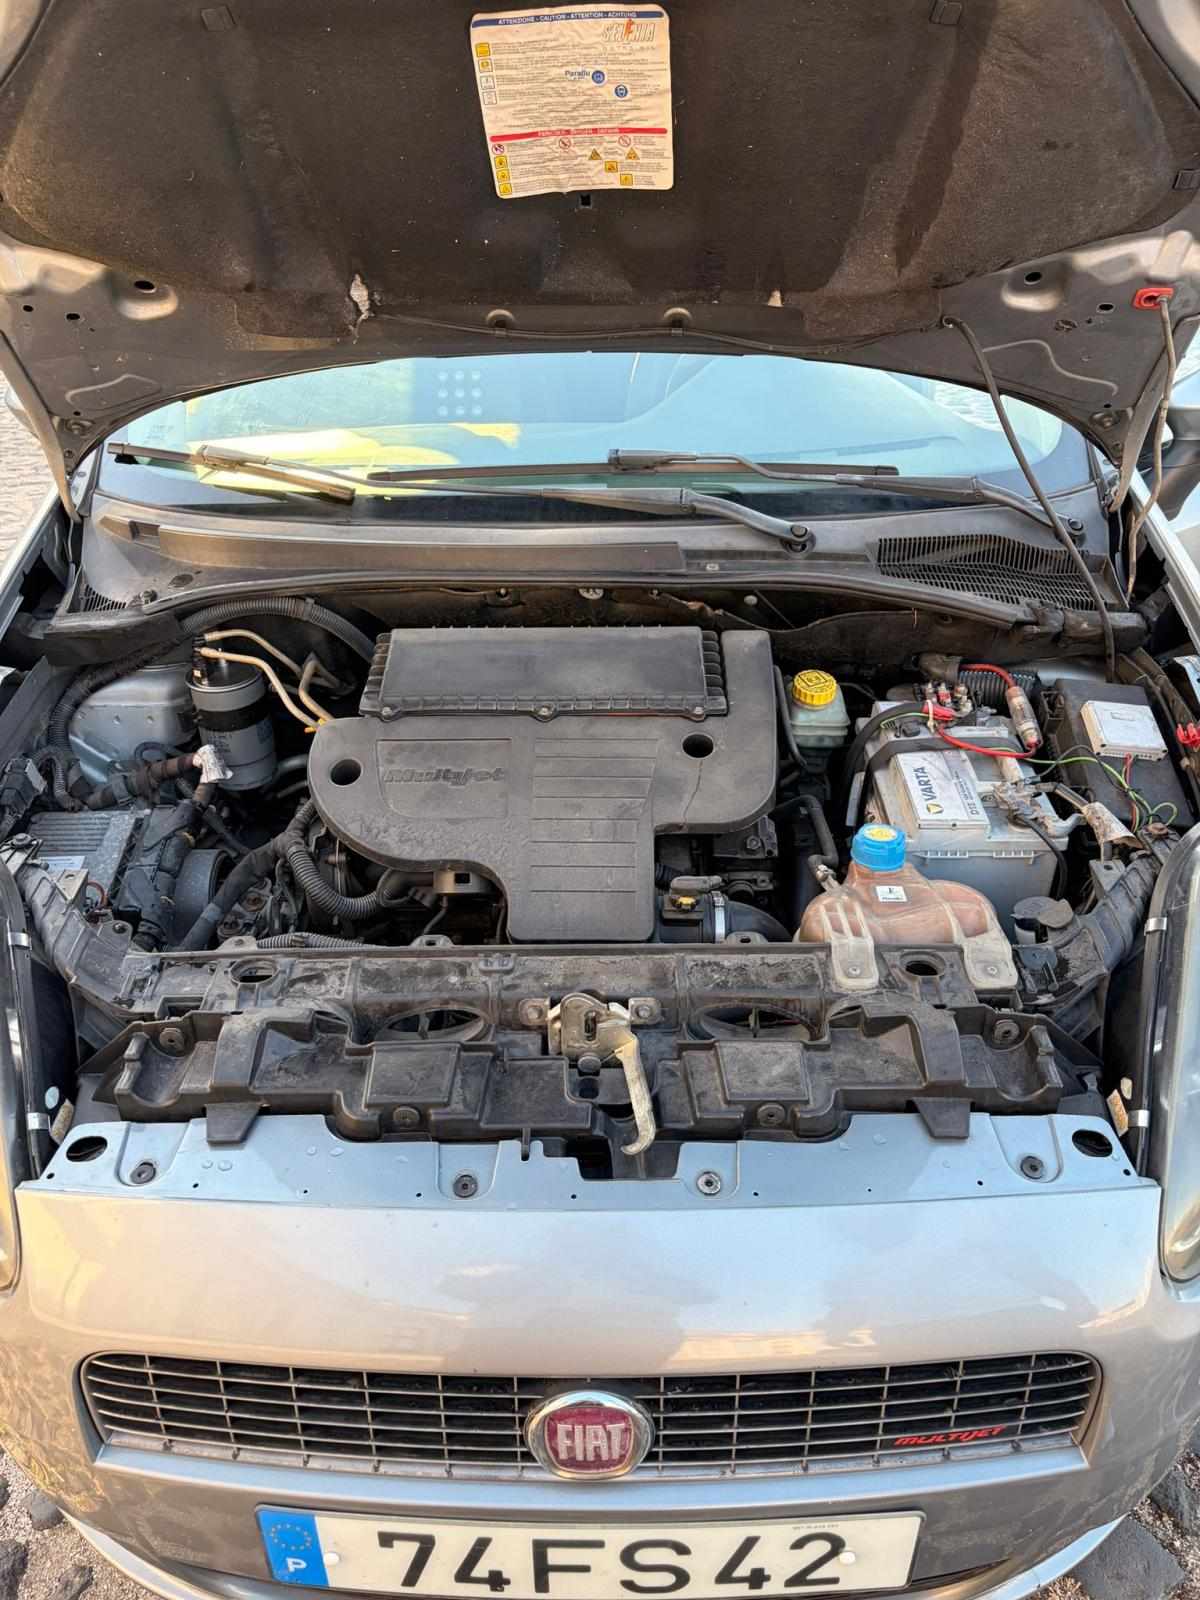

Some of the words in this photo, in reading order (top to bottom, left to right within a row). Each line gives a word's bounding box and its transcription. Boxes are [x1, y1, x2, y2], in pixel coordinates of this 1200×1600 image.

[540, 13, 566, 22] CAUTION
[912, 766, 937, 801] VARTA
[557, 1423, 626, 1461] FIAT
[286, 1557, 307, 1573] P
